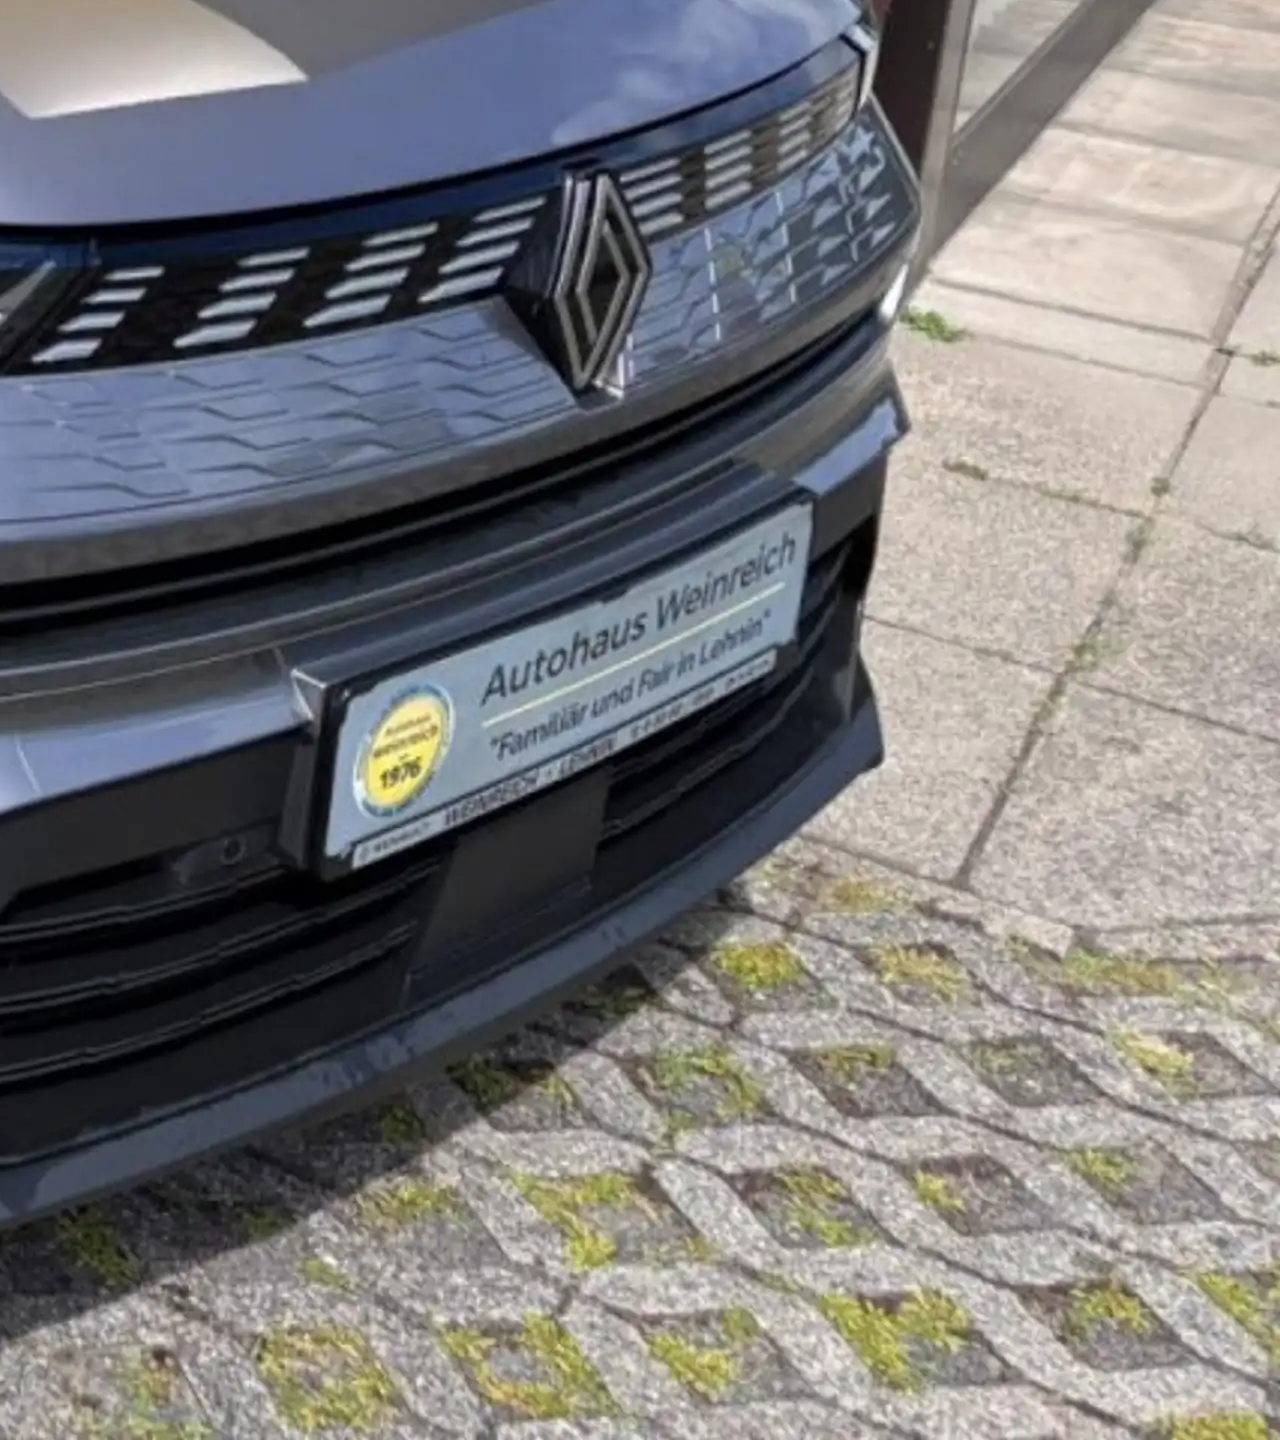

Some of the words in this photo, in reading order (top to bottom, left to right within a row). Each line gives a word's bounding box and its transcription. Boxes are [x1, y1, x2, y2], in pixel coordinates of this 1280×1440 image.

[480, 606, 646, 707] Autohaus
[655, 531, 797, 629] Weinreich
[592, 677, 636, 720] und
